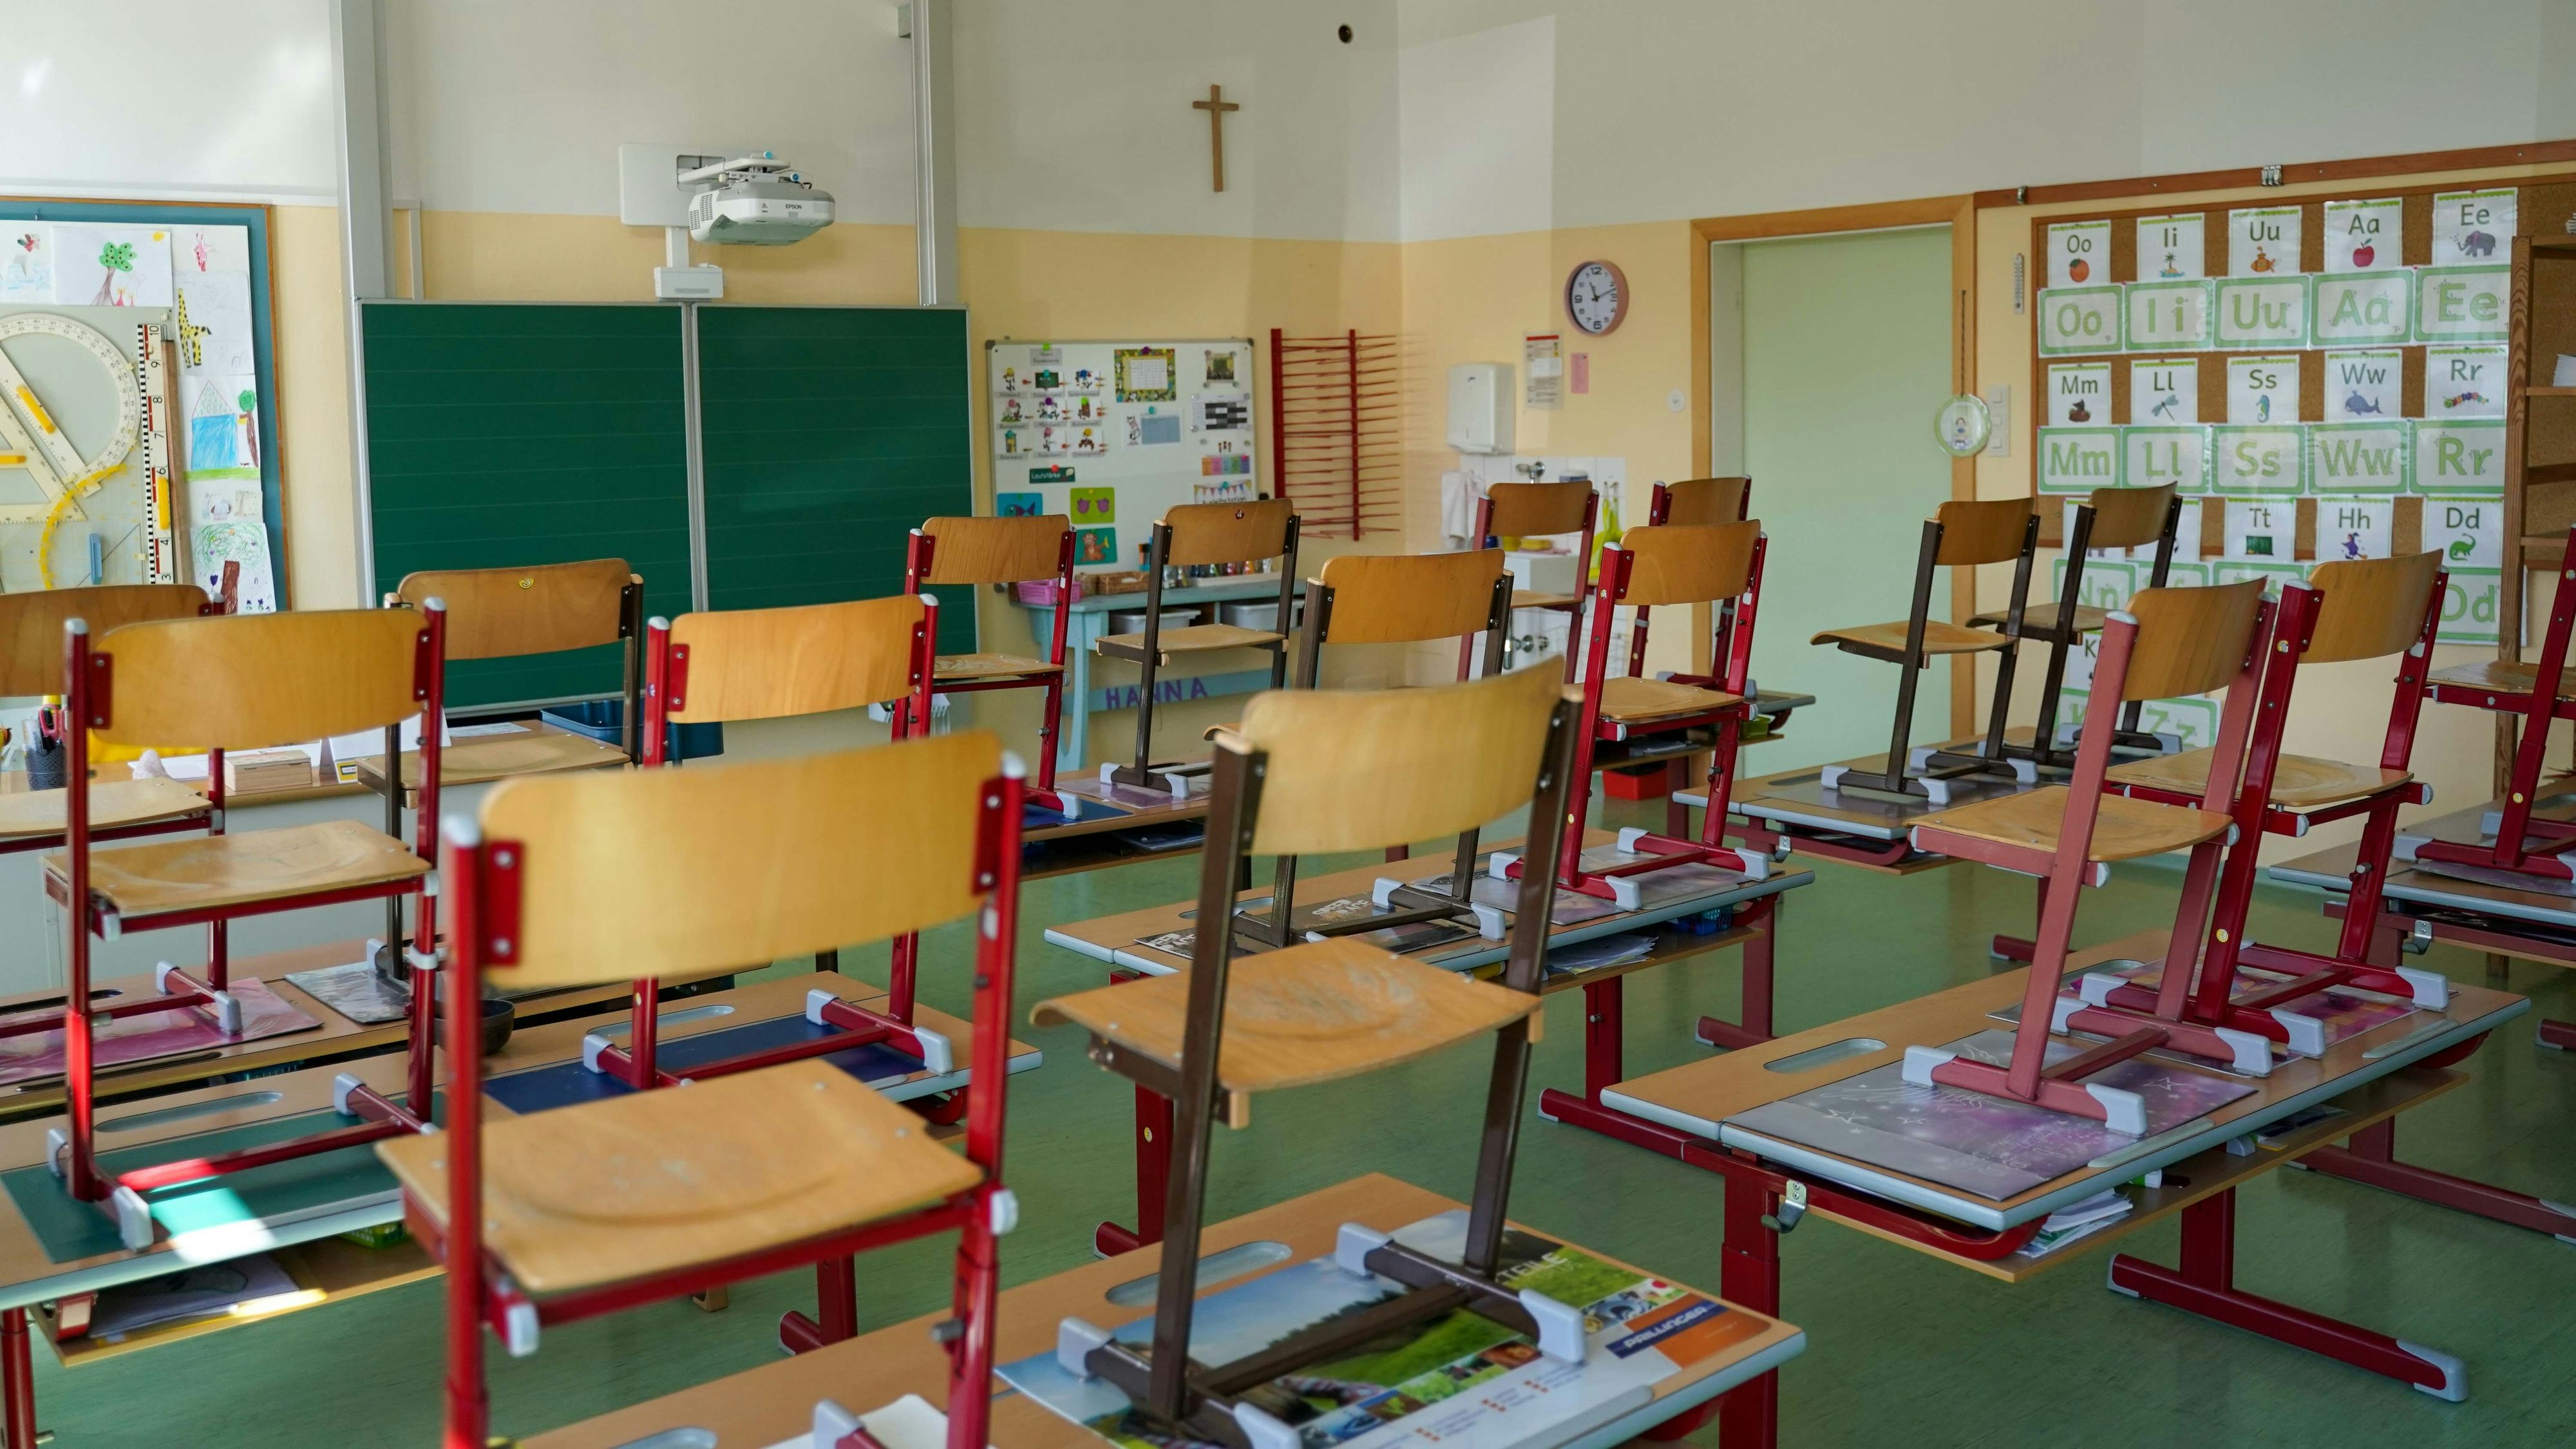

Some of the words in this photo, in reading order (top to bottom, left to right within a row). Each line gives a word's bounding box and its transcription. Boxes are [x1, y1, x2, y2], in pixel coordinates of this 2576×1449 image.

[2348, 214, 2380, 235] Aa
[2461, 204, 2490, 225] Ee
[2163, 227, 2177, 247] Ii
[2249, 221, 2280, 242] Uu
[2067, 234, 2092, 254] Oo
[1591, 267, 1602, 275] 12
[2233, 293, 2287, 330] Uu
[2331, 289, 2390, 327] Aa
[2438, 282, 2499, 322] Ee
[149, 325, 160, 336] 10
[2057, 303, 2102, 337] Oo
[2249, 370, 2277, 389] Ss
[2342, 363, 2386, 385] Ww
[2450, 359, 2483, 381] Rr
[2061, 375, 2098, 394] Mm
[2154, 371, 2175, 391] Ll
[2050, 442, 2110, 476] Mm
[2145, 441, 2183, 477] Ll
[2235, 441, 2282, 478] Ss
[2321, 439, 2394, 477] Ww
[2438, 437, 2493, 476] Rr
[1237, 509, 1242, 518] 4
[2249, 507, 2271, 528] Tt
[2338, 507, 2371, 529] Hh
[2446, 507, 2480, 529] Dd
[522, 578, 531, 587] 3
[2440, 584, 2496, 623] Dd
[2085, 639, 2101, 658] K
[2220, 929, 2227, 940] 3
